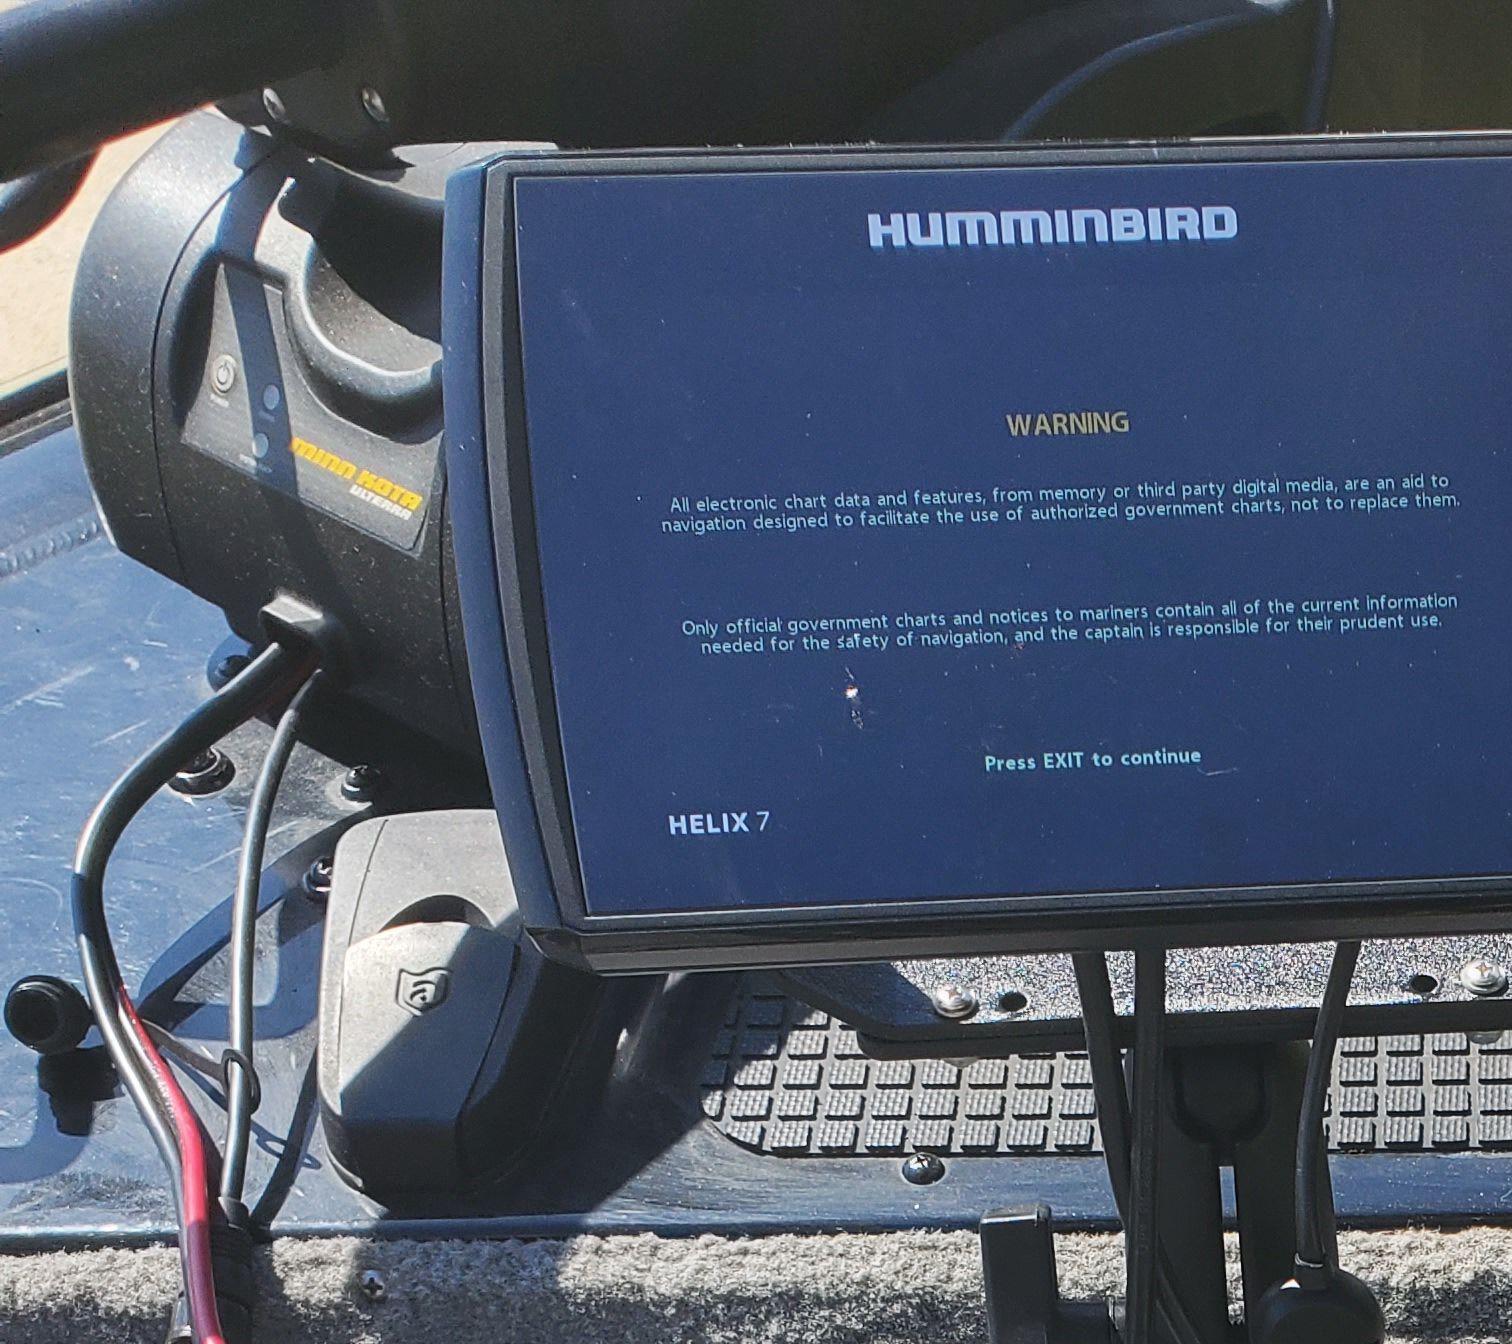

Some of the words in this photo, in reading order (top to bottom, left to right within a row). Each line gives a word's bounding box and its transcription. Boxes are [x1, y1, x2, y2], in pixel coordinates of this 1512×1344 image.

[867, 205, 1238, 248] HUMMINBIRD
[1005, 411, 1130, 437] WARNING
[356, 470, 423, 511] KOTA
[670, 496, 690, 513] All
[696, 494, 778, 512] electronic
[784, 493, 827, 509] chart
[834, 491, 871, 508] data
[877, 489, 908, 507] and
[913, 489, 986, 506] features,
[992, 487, 1033, 503] from
[1039, 487, 1106, 503] memory
[1113, 486, 1130, 499] or
[1137, 480, 1176, 498] third
[1181, 481, 1226, 501] party
[1232, 477, 1280, 498] digital
[1285, 476, 1338, 494] media,
[1344, 478, 1370, 491] are
[1376, 478, 1395, 491] an
[1401, 472, 1425, 489] aid
[1430, 474, 1449, 488] to
[661, 515, 747, 536] navigation
[753, 511, 829, 533] designed
[834, 513, 854, 527] to
[859, 509, 930, 527] facilitate
[936, 507, 964, 524] the
[970, 510, 999, 523] use
[1006, 505, 1024, 521] of
[1031, 502, 1118, 520] authorized
[1124, 500, 1225, 521] government
[1231, 497, 1285, 515] charts,
[1291, 497, 1319, 513] not
[1325, 496, 1344, 511] to
[1350, 493, 1409, 514] replace
[1414, 491, 1460, 508] them.
[682, 619, 719, 639] Only
[726, 616, 782, 634] official
[787, 614, 889, 636] government
[895, 612, 946, 628] charts
[953, 608, 983, 626] and
[989, 607, 1049, 625] notices
[1054, 607, 1074, 622] to
[1079, 604, 1149, 621] mariners
[1155, 601, 1215, 618] contain
[1221, 599, 1237, 616] all
[1243, 599, 1261, 615] of
[1267, 598, 1295, 614] the
[1301, 597, 1360, 613] current
[1366, 592, 1458, 611] information
[701, 636, 764, 654] needed
[770, 636, 795, 652] for
[801, 634, 830, 651] the
[837, 632, 889, 651] safety
[896, 630, 914, 647] of
[920, 628, 1008, 649] navigation,
[1014, 626, 1044, 643] and
[1050, 624, 1078, 641] the
[1084, 622, 1144, 644] captain
[1149, 621, 1161, 638] is
[1167, 618, 1259, 640] responsible
[1265, 617, 1290, 633] for
[1296, 615, 1333, 632] their
[1339, 613, 1404, 635] prudent
[1410, 615, 1442, 628] use.
[984, 755, 1036, 772] Press
[1043, 751, 1084, 769] EXIT
[1092, 752, 1113, 767] to
[1120, 747, 1202, 766] continue
[668, 811, 750, 836] HELIX
[756, 810, 770, 832] 7
